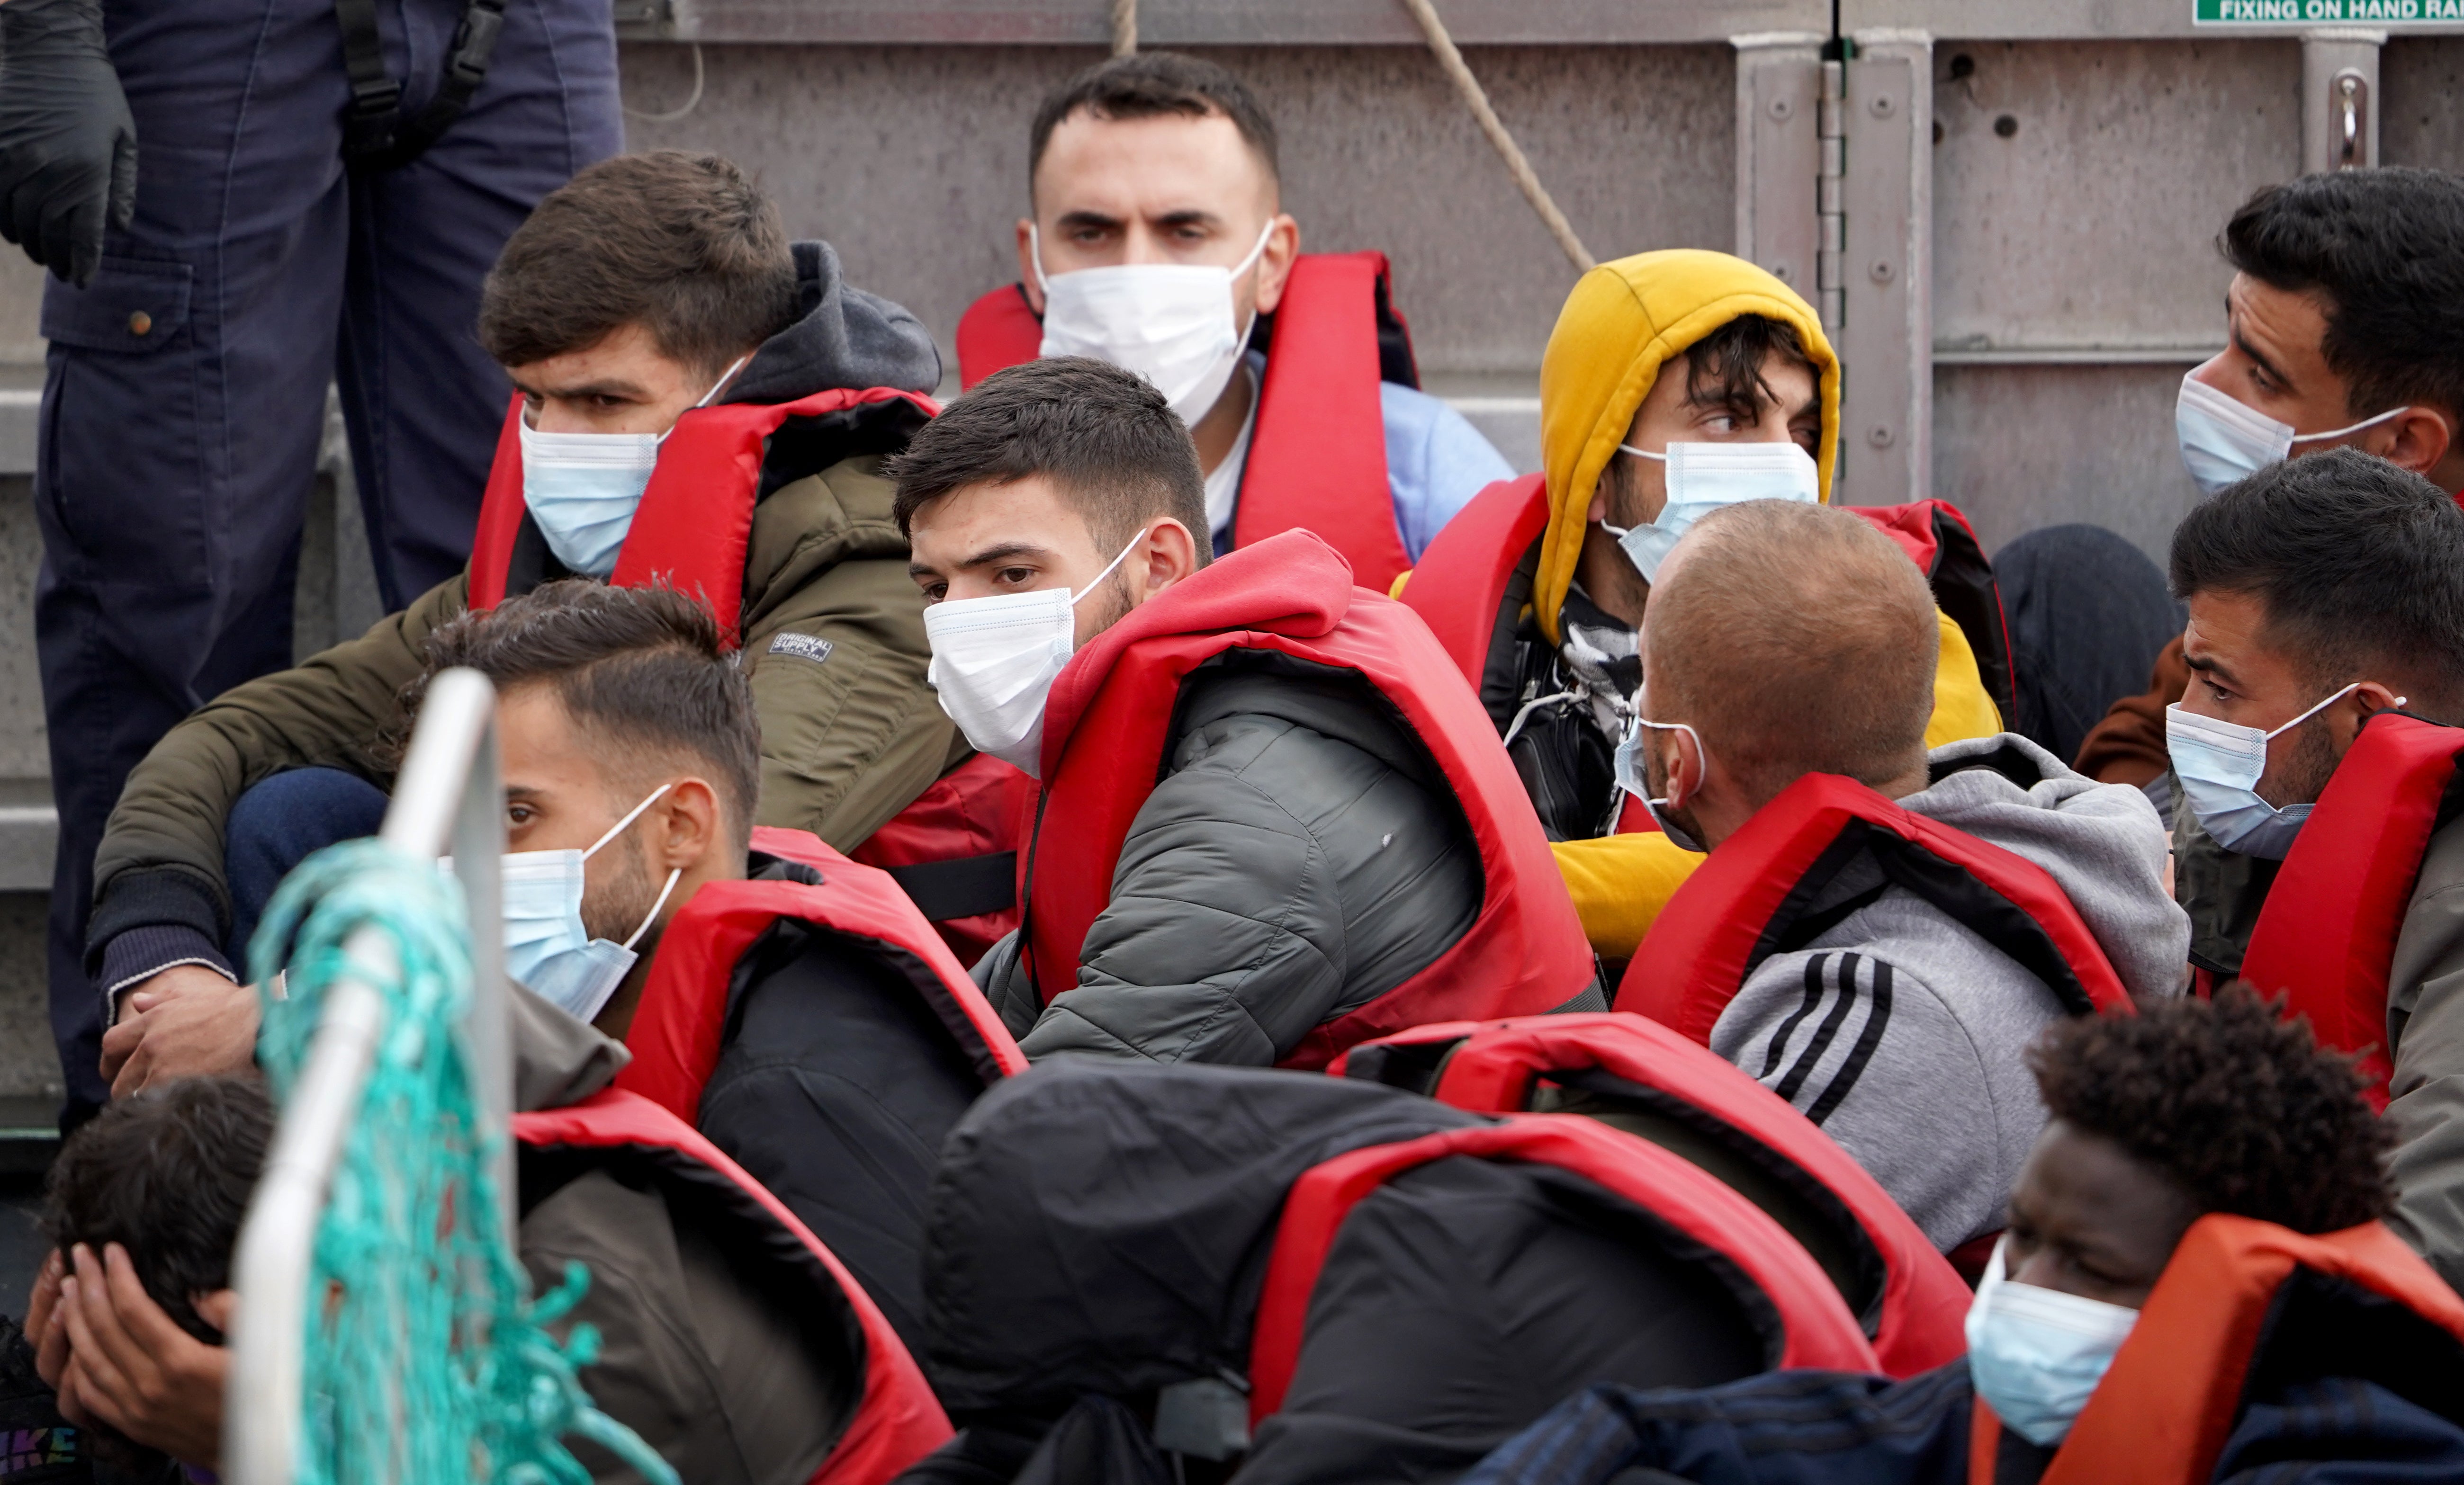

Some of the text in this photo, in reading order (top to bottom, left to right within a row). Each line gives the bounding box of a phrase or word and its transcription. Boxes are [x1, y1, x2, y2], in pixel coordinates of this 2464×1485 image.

[2220, 0, 2299, 19] FIXING
[2306, 0, 2342, 19] ON
[2349, 0, 2418, 19] HAND
[774, 640, 818, 653] SUPPLY
[778, 633, 828, 650] ORIGINAL
